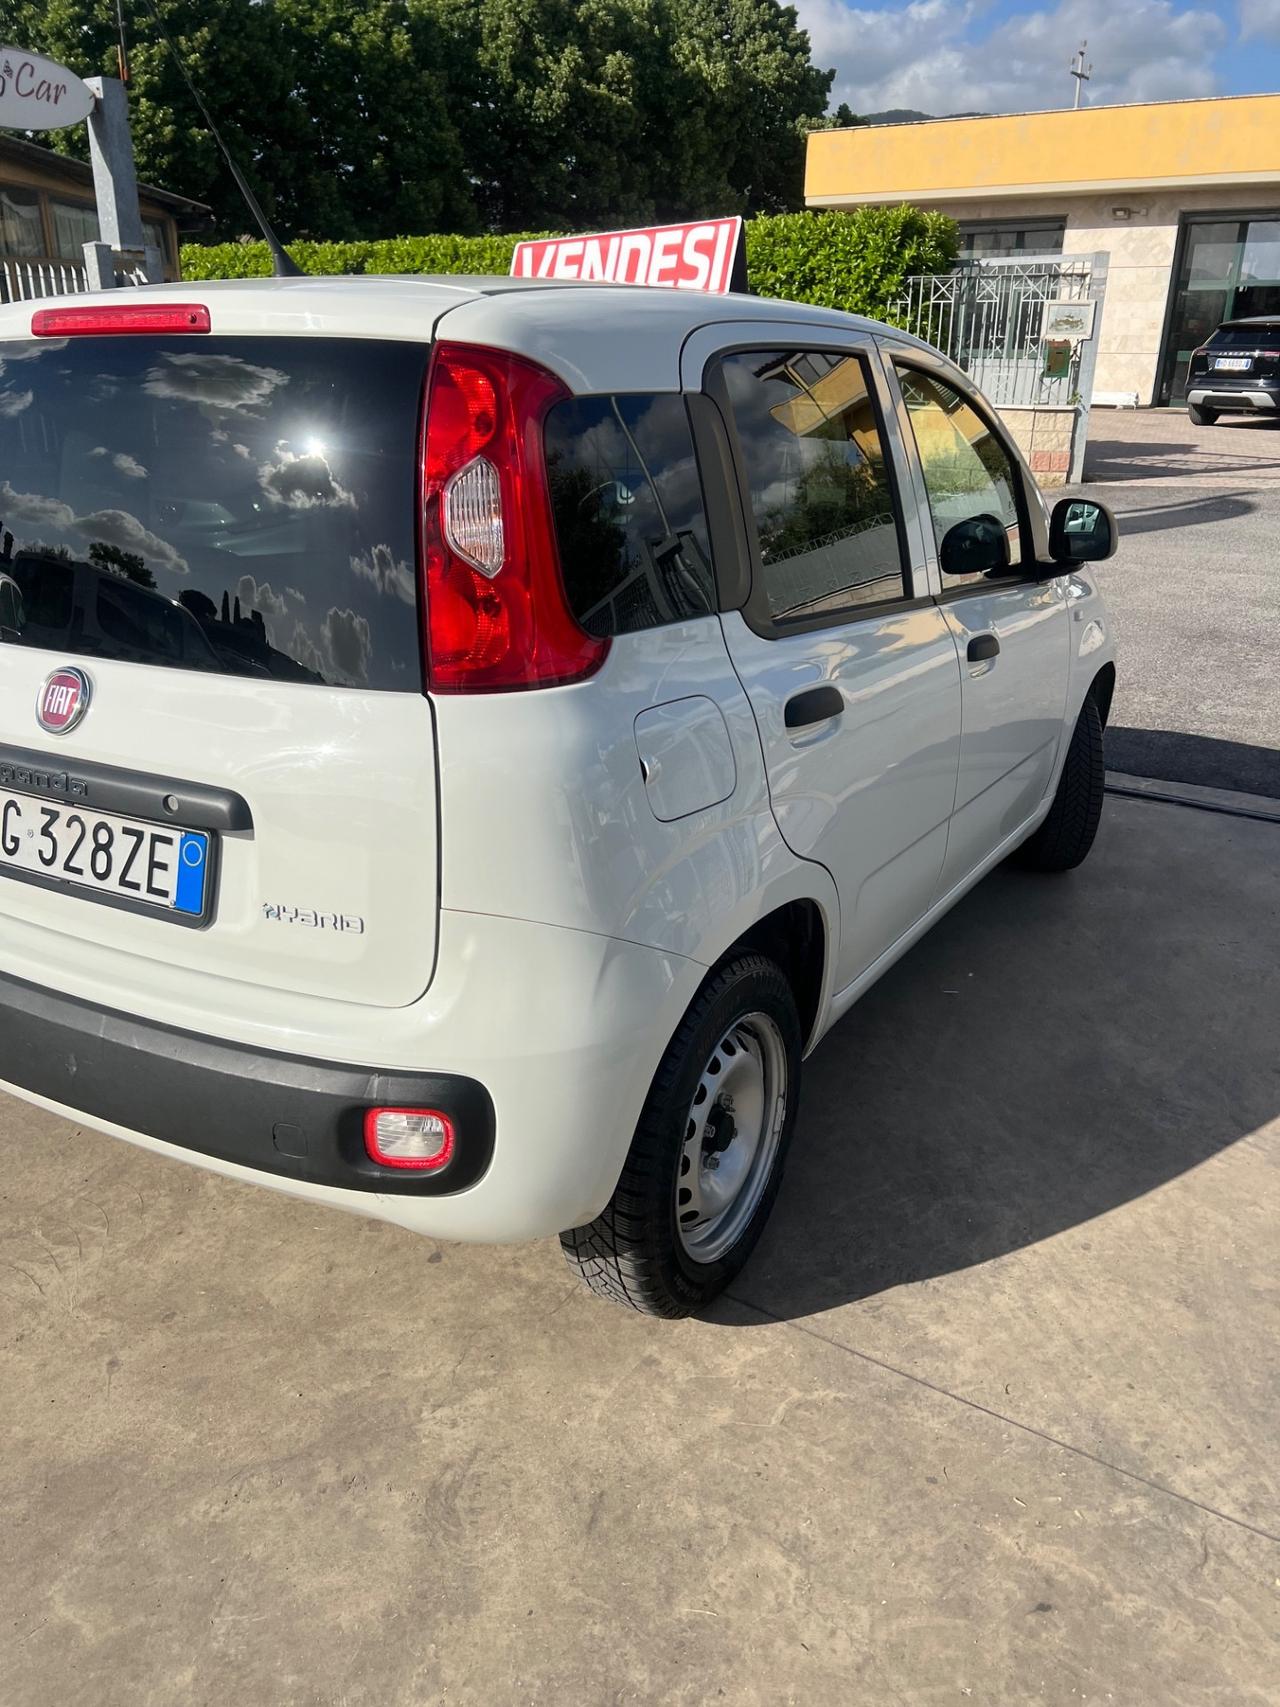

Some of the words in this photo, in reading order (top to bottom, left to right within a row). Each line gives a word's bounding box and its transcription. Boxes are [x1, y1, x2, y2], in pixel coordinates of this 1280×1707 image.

[15, 62, 67, 104] Car
[521, 223, 731, 294] VENDESI
[43, 684, 77, 716] FIAT
